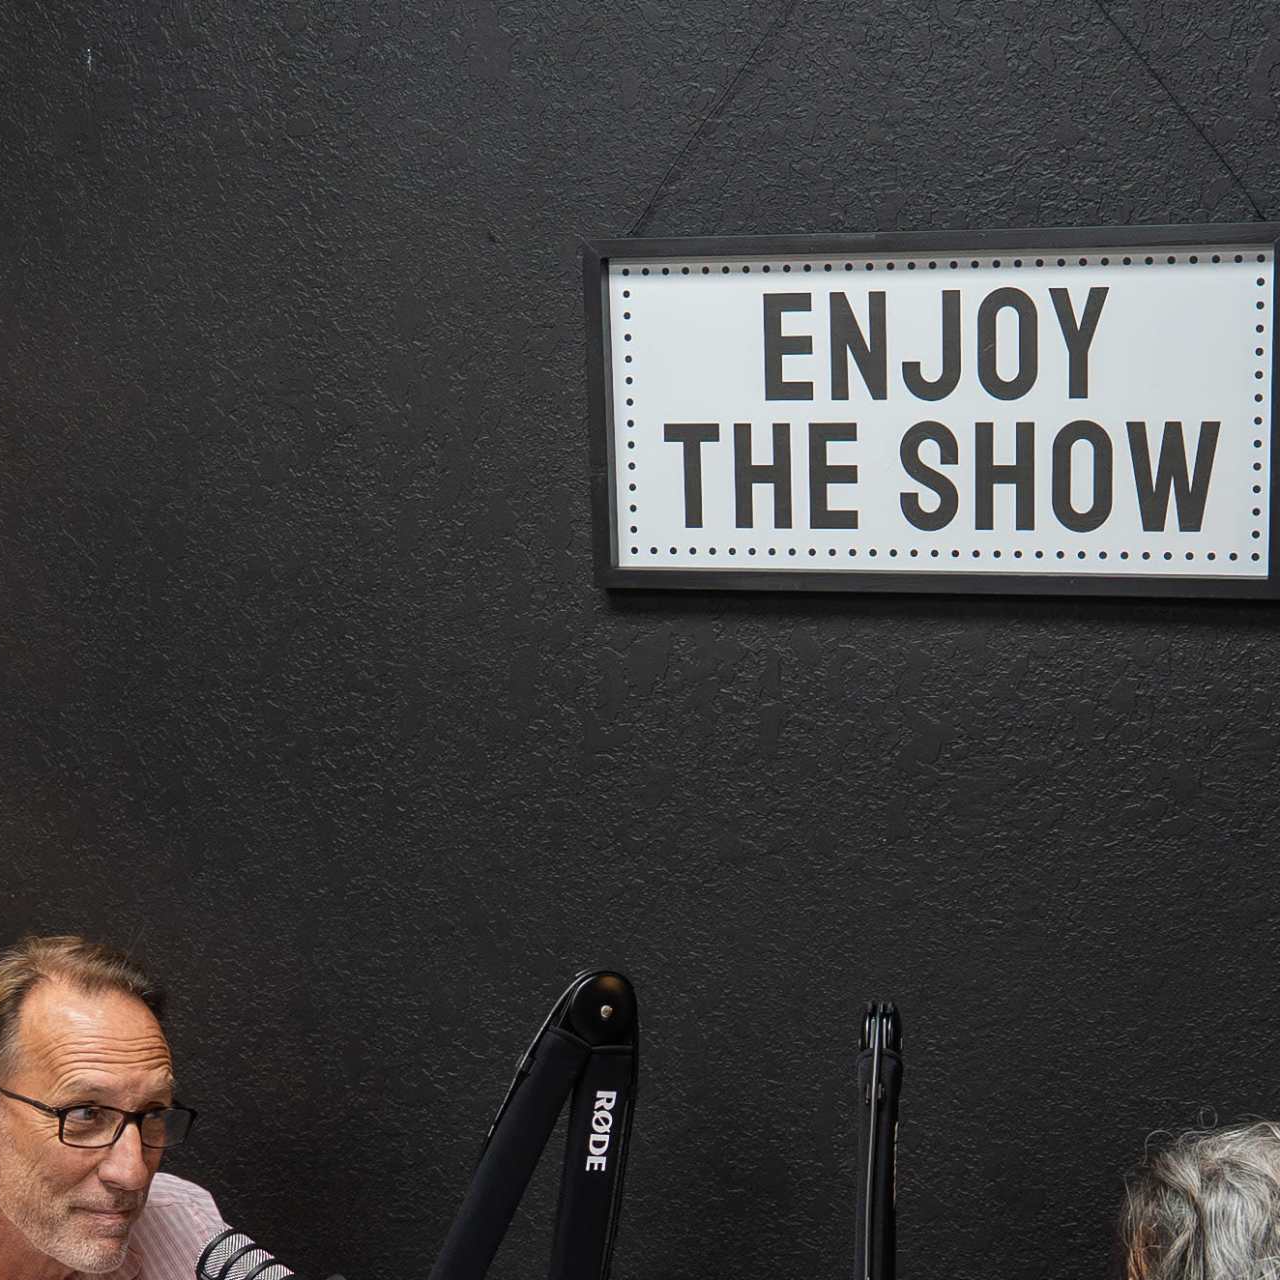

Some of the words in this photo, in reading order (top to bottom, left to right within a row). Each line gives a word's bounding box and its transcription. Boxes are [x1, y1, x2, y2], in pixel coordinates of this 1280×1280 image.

[763, 287, 1110, 402] ENJOY
[663, 423, 859, 529] THE
[899, 420, 1221, 532] SHOW
[585, 1090, 617, 1172] RØDE
